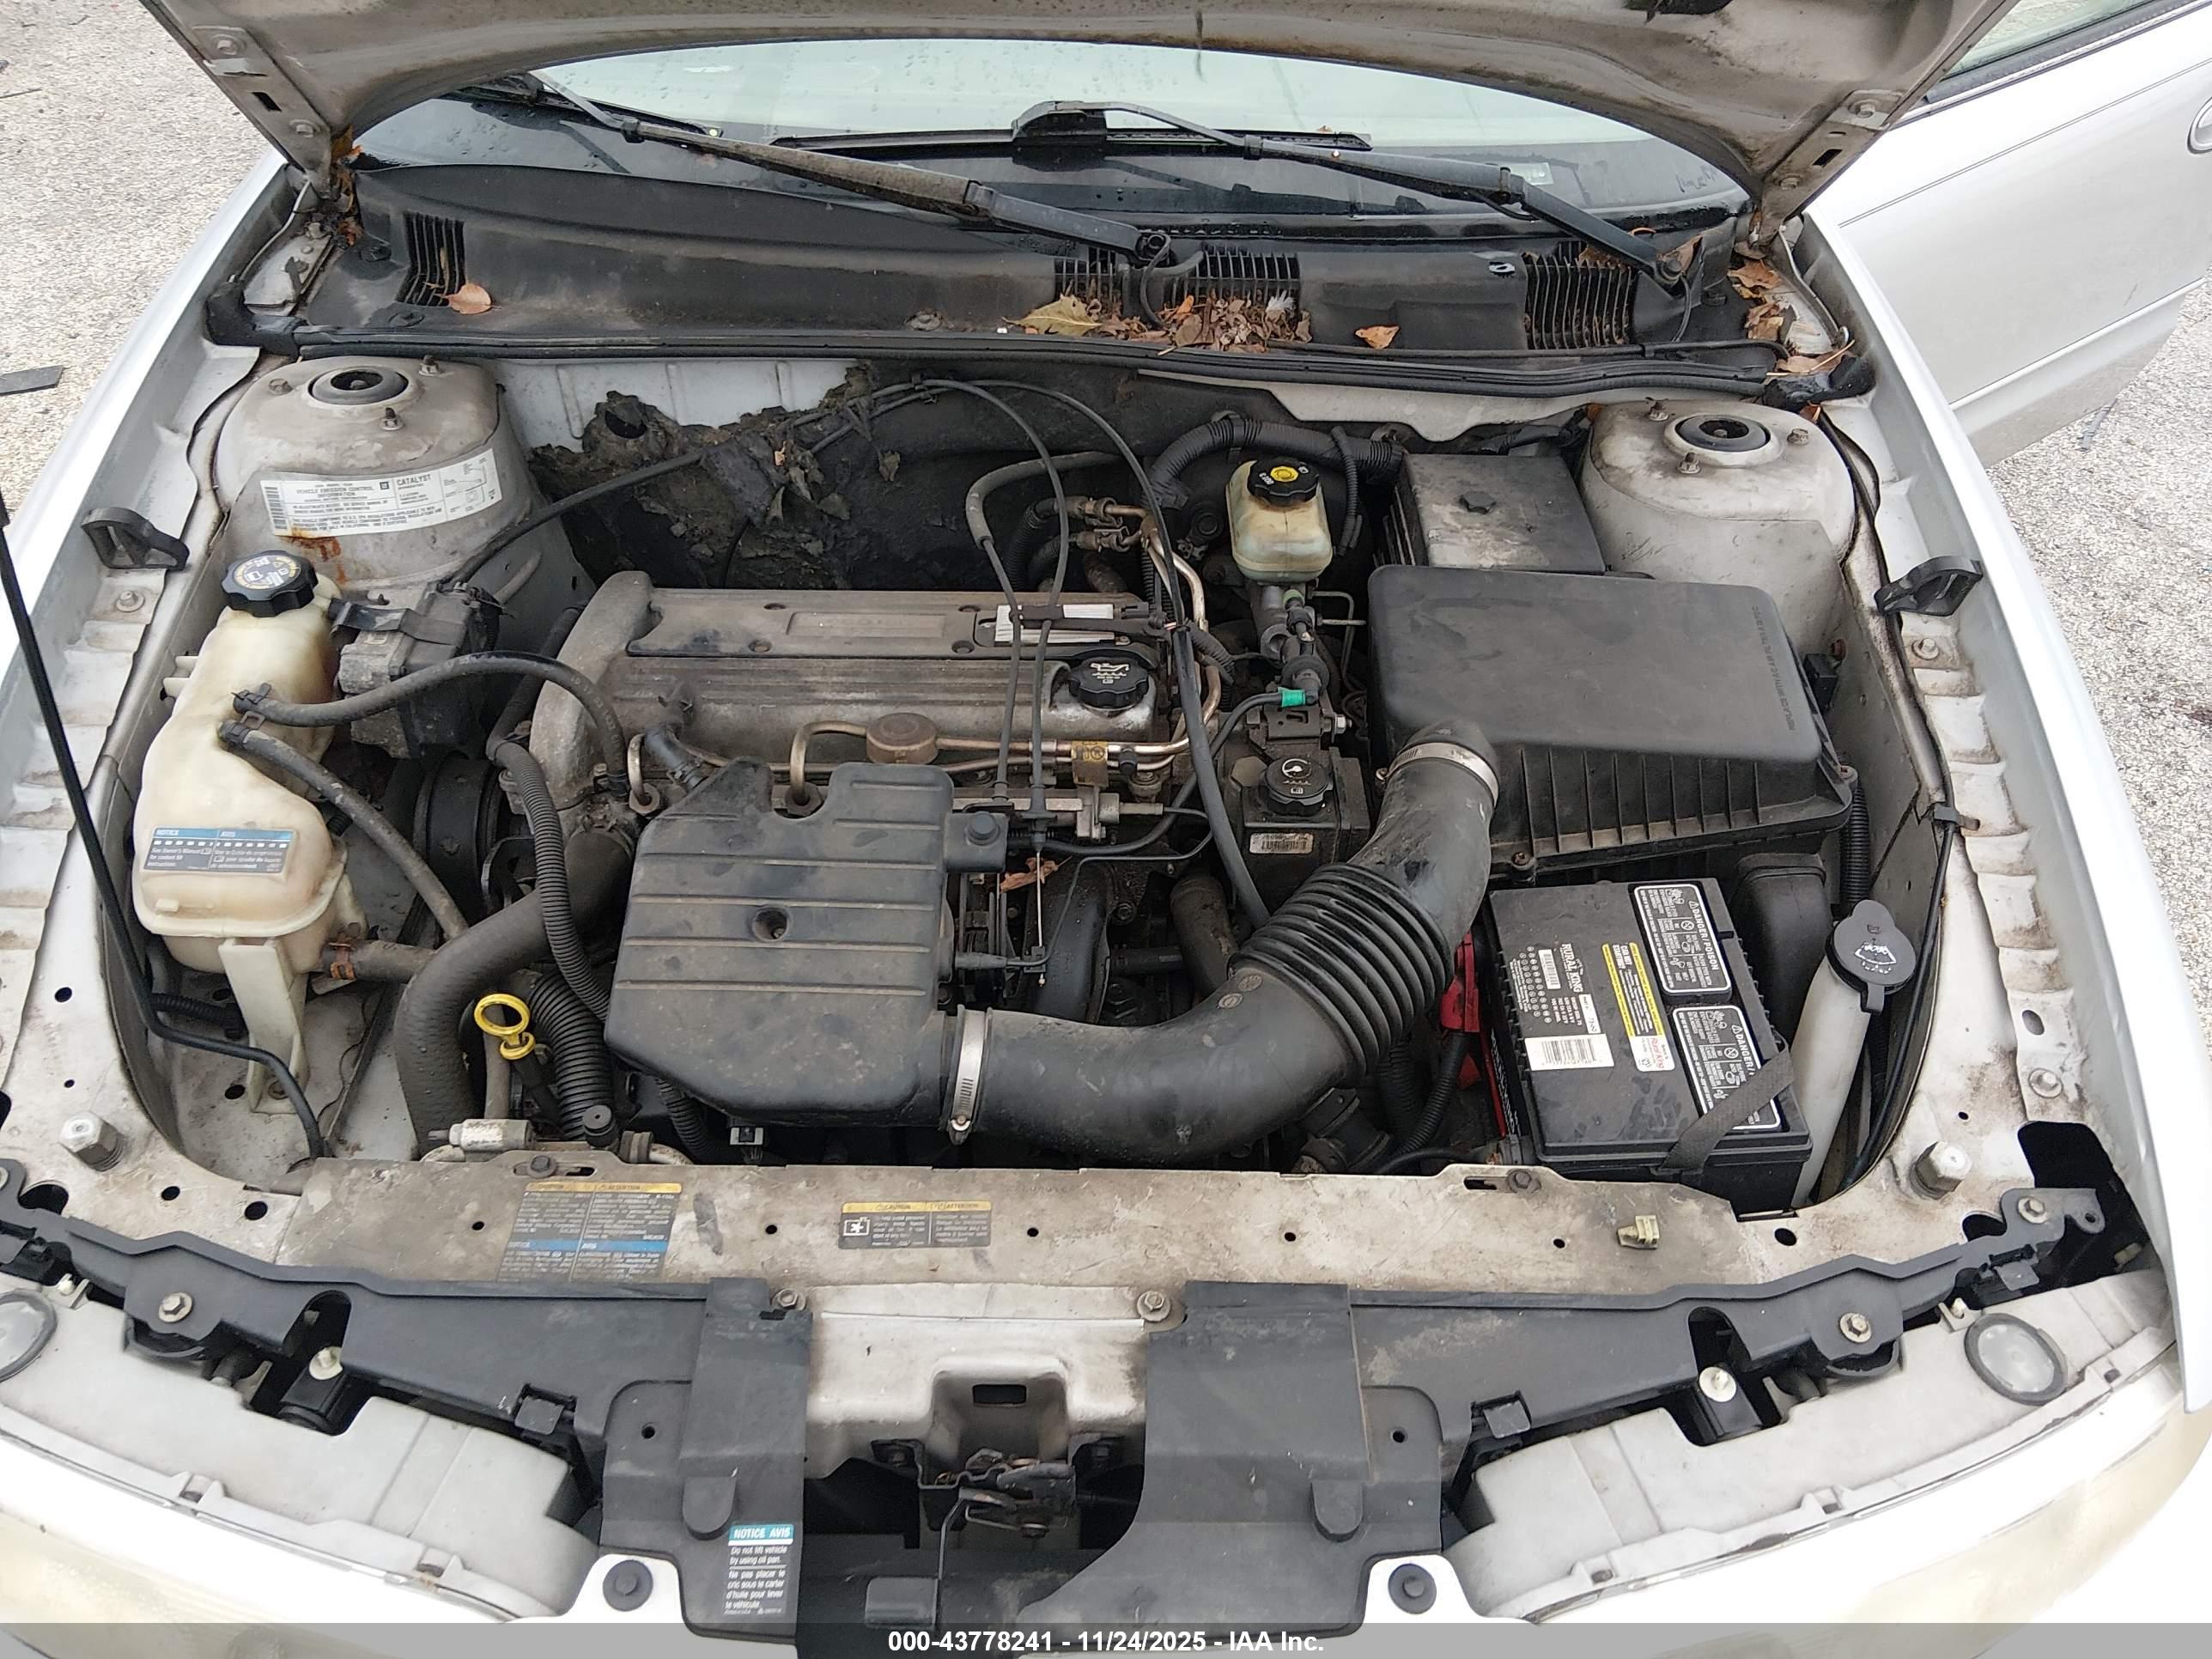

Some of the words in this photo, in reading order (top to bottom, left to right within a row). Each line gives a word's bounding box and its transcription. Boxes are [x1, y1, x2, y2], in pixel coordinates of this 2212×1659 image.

[397, 474, 431, 486] CATALYST
[1691, 908, 1719, 969] DANGER/POISON
[1561, 943, 1574, 971] RURAL
[1571, 972, 1583, 993] KING
[1734, 1033, 1756, 1075] DANGER/
[733, 1528, 766, 1539] NOTICE
[769, 1527, 791, 1538] AVIS
[765, 1546, 787, 1554] vehicle
[730, 1557, 738, 1566] by
[739, 1557, 757, 1565] using
[729, 1571, 738, 1579] Ne
[756, 1570, 776, 1579] placer
[778, 1570, 786, 1578] le
[750, 1590, 765, 1600] pour
